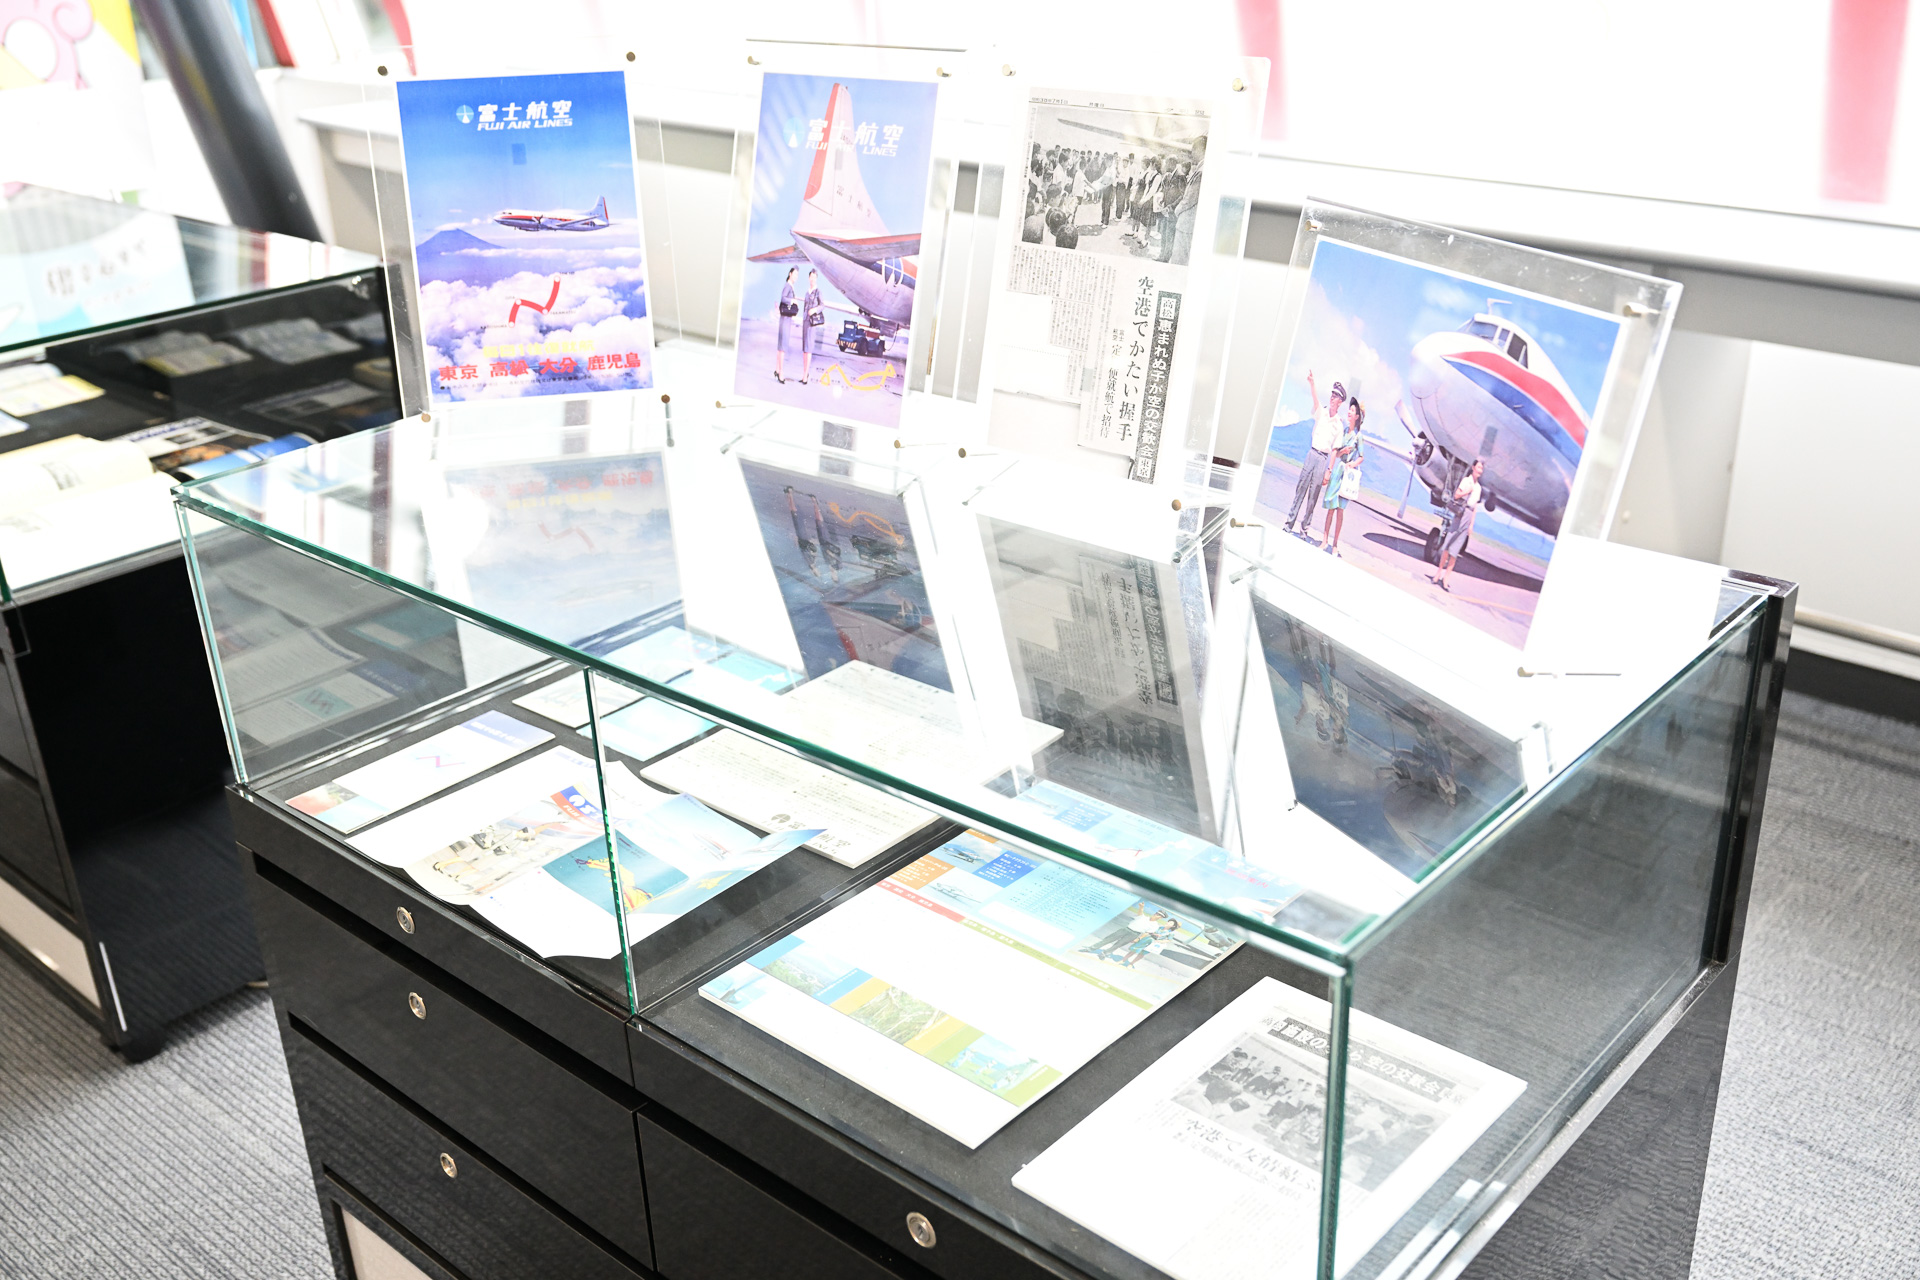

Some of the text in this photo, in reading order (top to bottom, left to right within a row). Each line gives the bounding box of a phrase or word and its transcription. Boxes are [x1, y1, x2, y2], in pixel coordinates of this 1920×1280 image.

[477, 99, 573, 123] 富士航空
[477, 117, 574, 131] FUJI AIR LINES
[807, 118, 904, 149] 富士航空
[805, 140, 829, 151] FUJI
[862, 146, 898, 157] LINES
[438, 352, 642, 382] 東京 高松 大分 鹿児島
[1116, 275, 1155, 443] 空港でかたい握手
